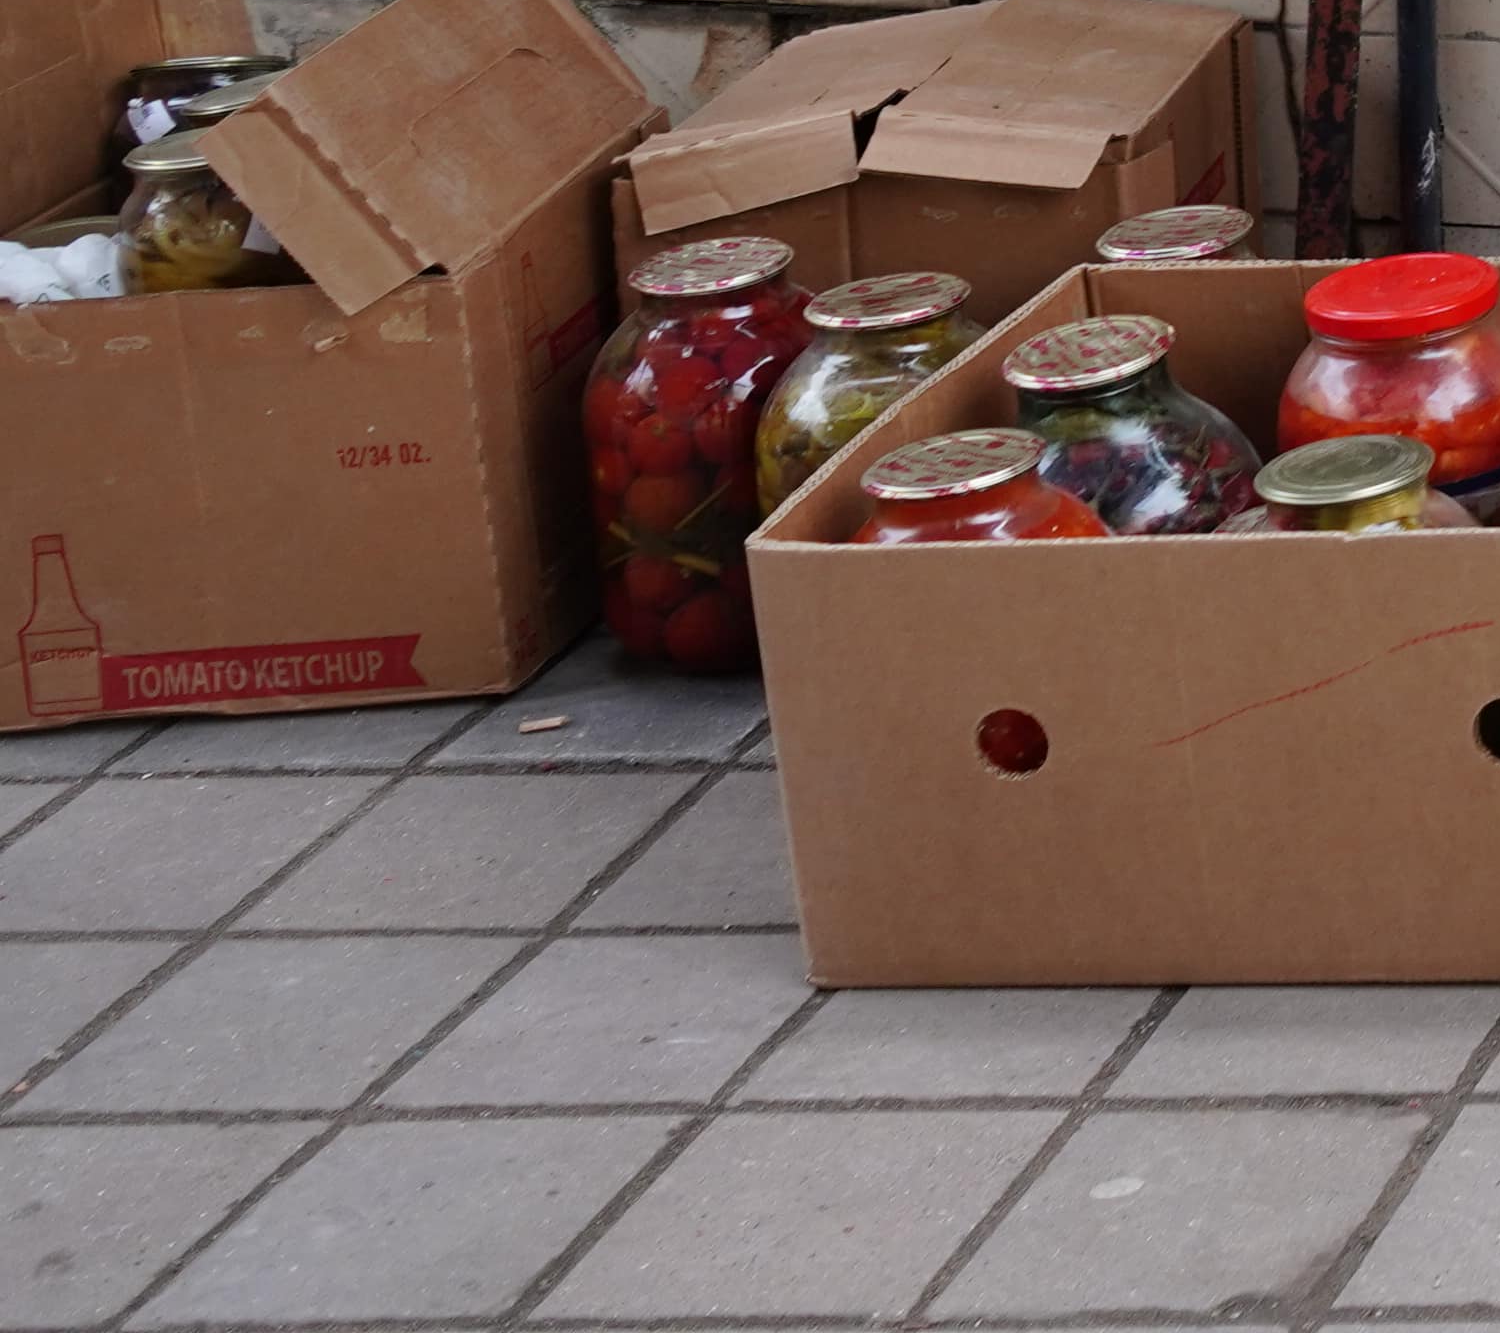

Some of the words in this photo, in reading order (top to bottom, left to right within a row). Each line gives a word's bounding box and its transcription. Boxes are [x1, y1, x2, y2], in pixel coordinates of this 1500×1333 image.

[336, 445, 393, 469] 12/34
[121, 664, 249, 700] TOMATO
[253, 649, 385, 691] KETCHUP
